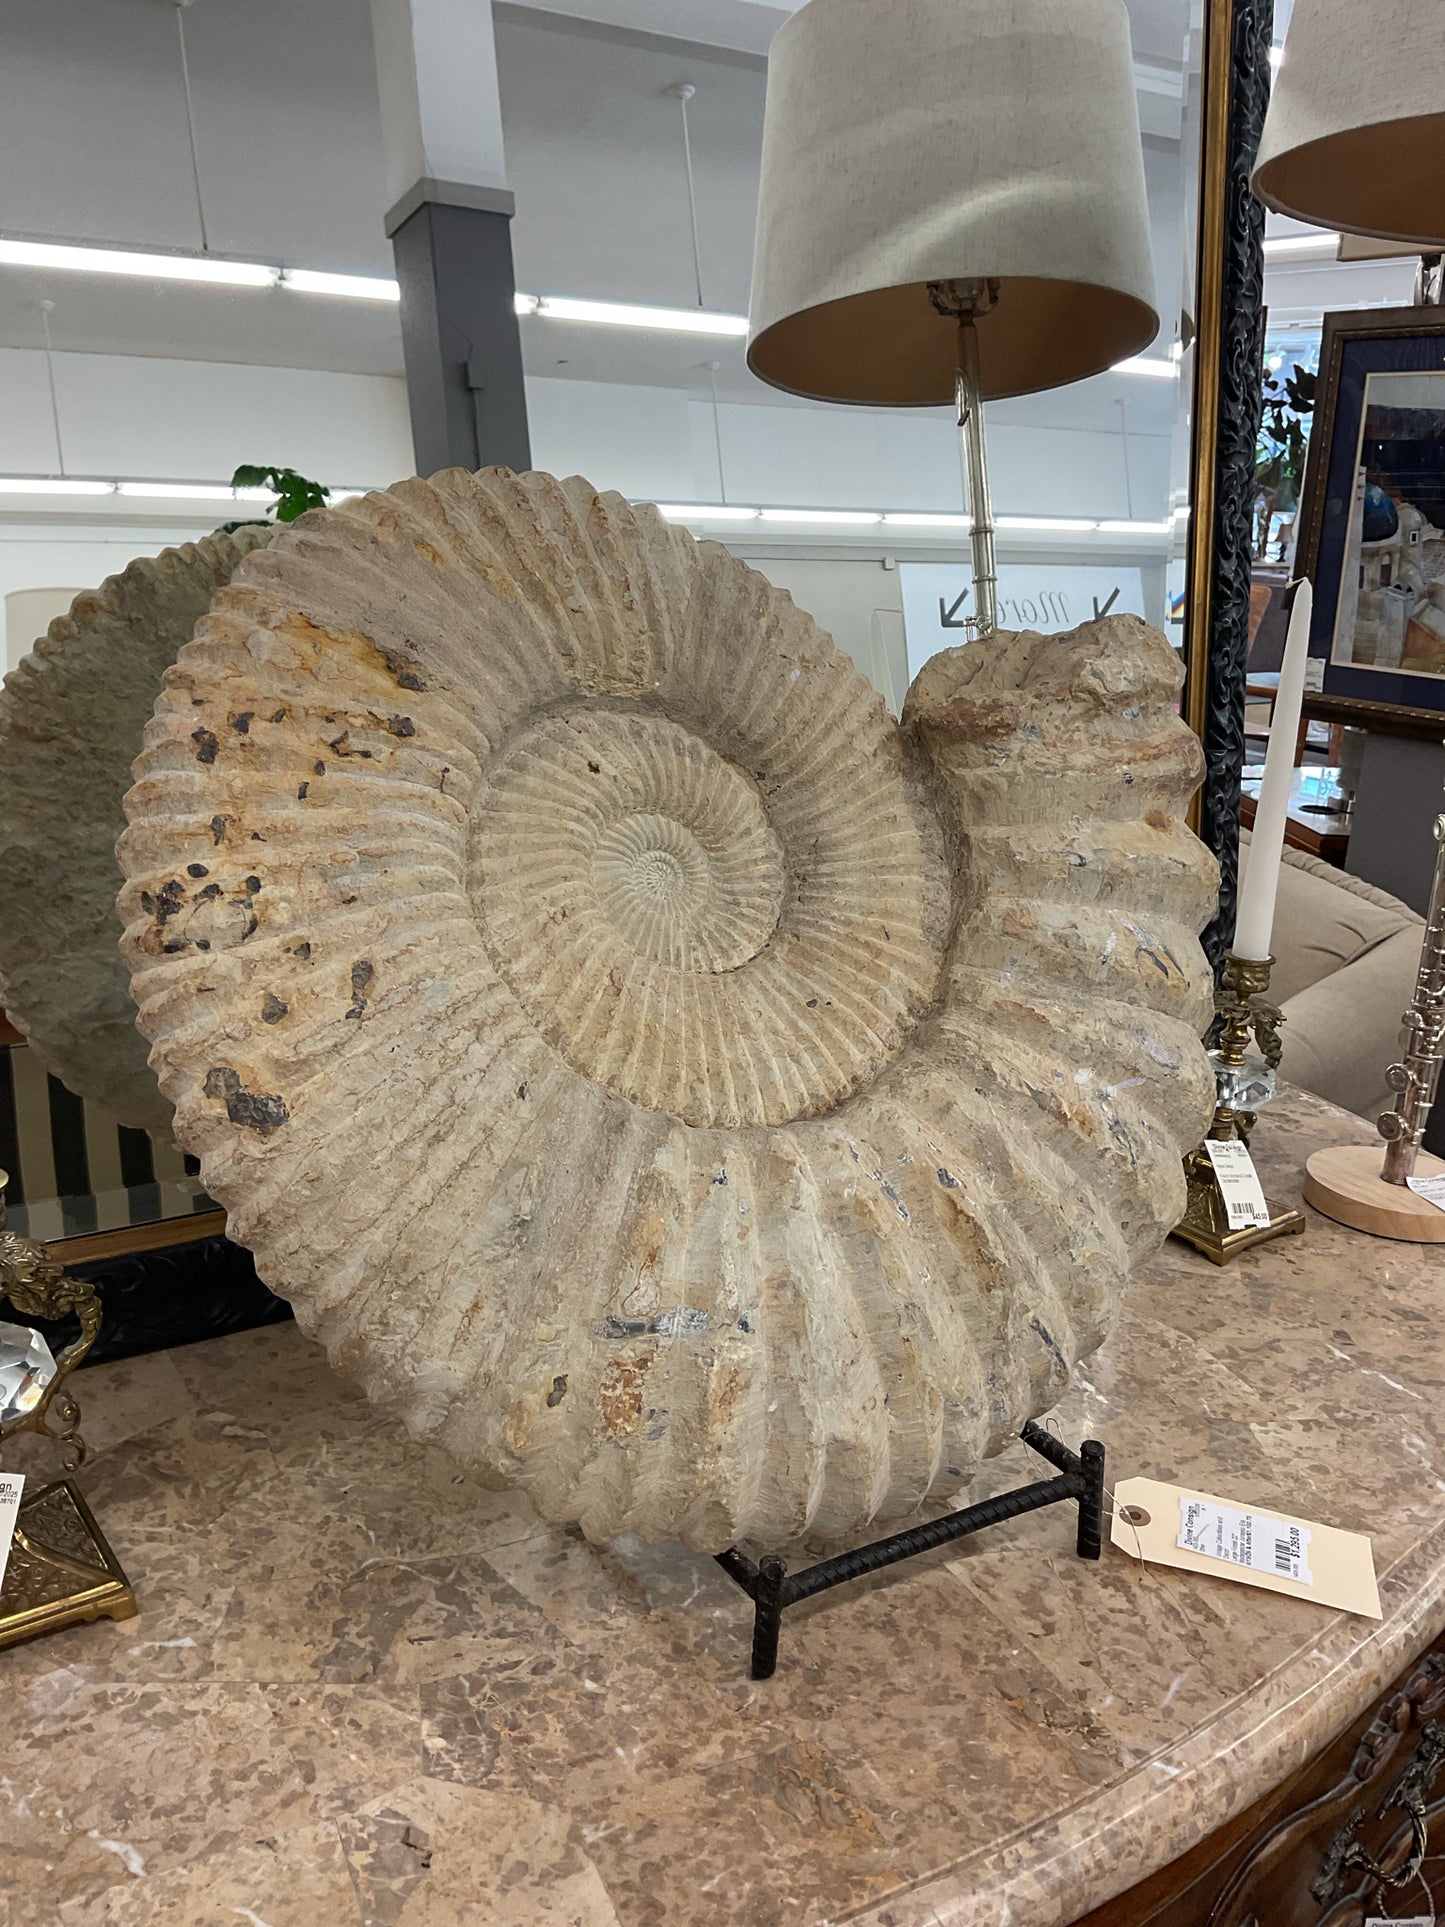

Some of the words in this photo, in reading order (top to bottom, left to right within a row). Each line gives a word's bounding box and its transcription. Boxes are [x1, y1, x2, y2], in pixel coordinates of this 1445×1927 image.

[1185, 1506, 1196, 1528] Consign
[1184, 1527, 1193, 1546] Divine
[1290, 1527, 1300, 1558] $1,295.00
